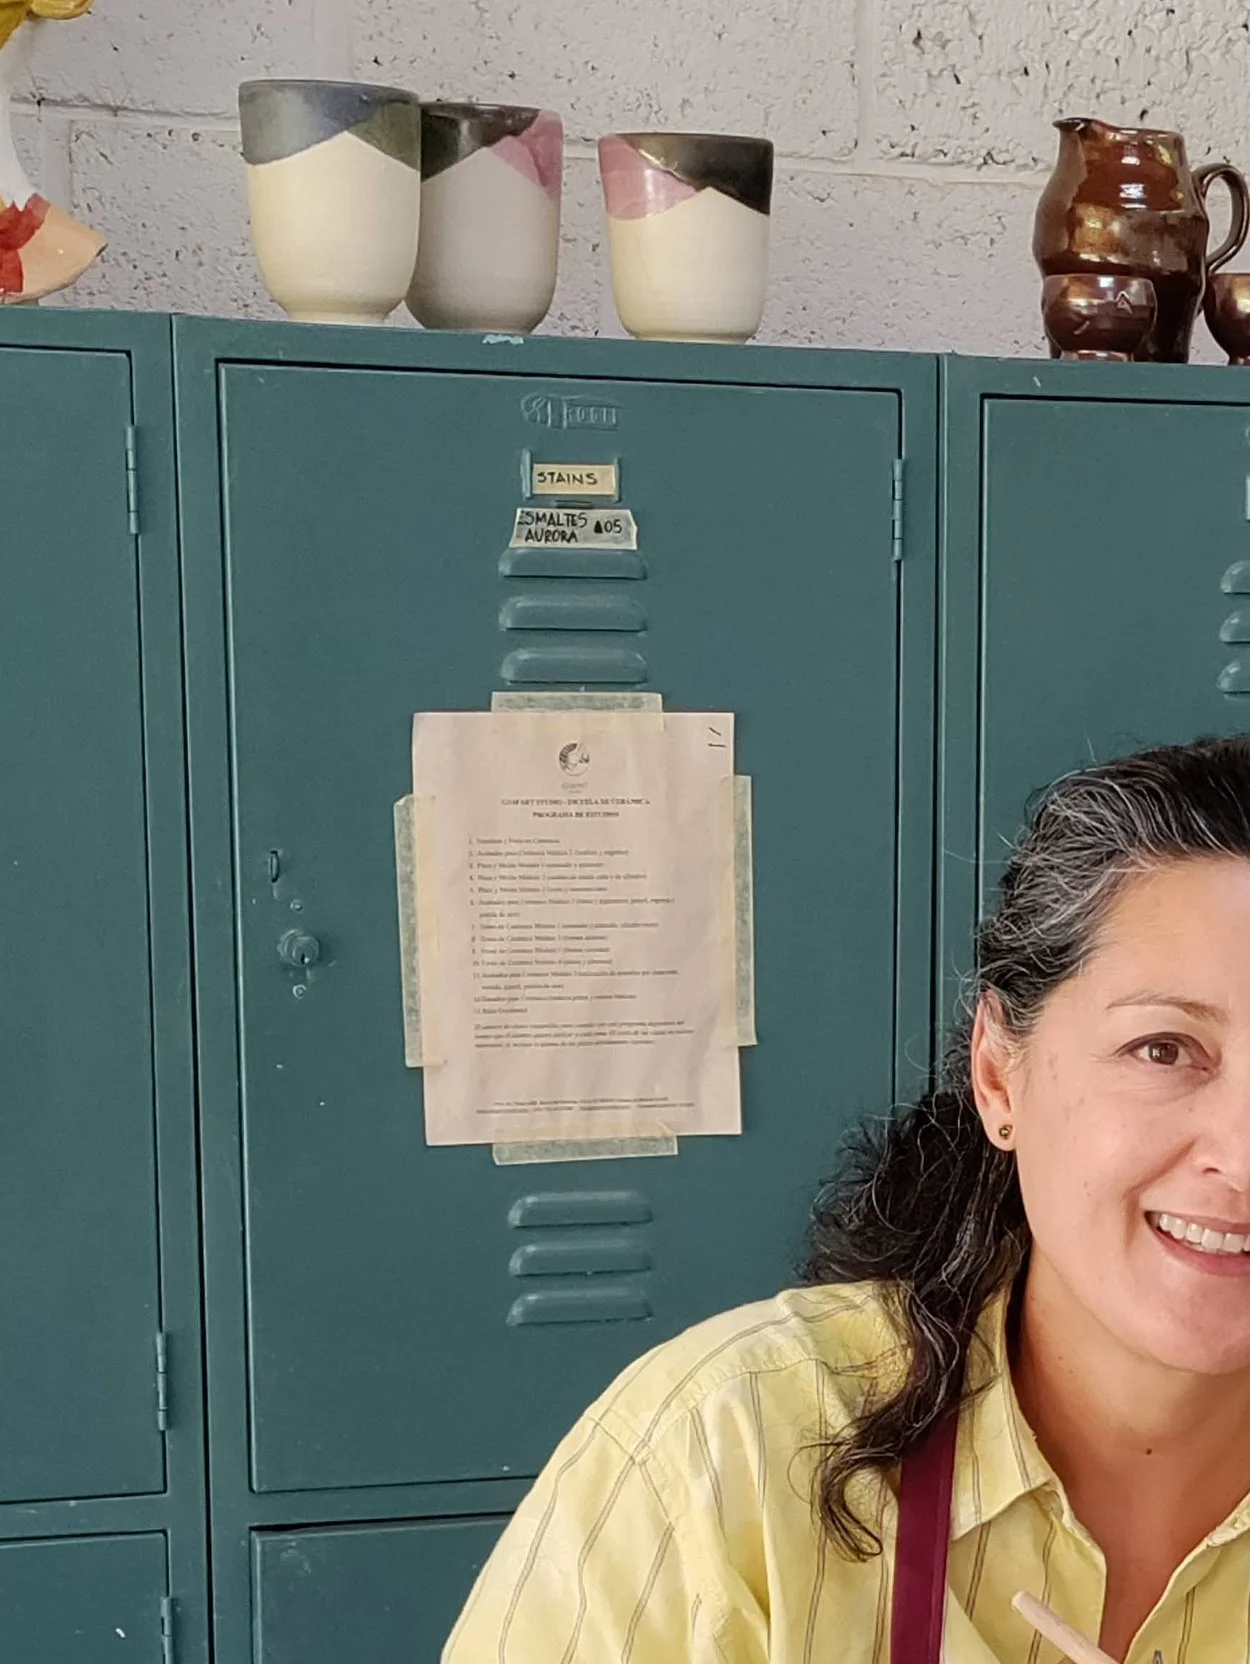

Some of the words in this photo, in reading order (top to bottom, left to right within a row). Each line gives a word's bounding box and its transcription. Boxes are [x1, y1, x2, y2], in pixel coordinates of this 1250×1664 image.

[536, 471, 598, 485] STAINS
[518, 510, 588, 528] ESMALTES
[525, 528, 579, 544] AURORA
